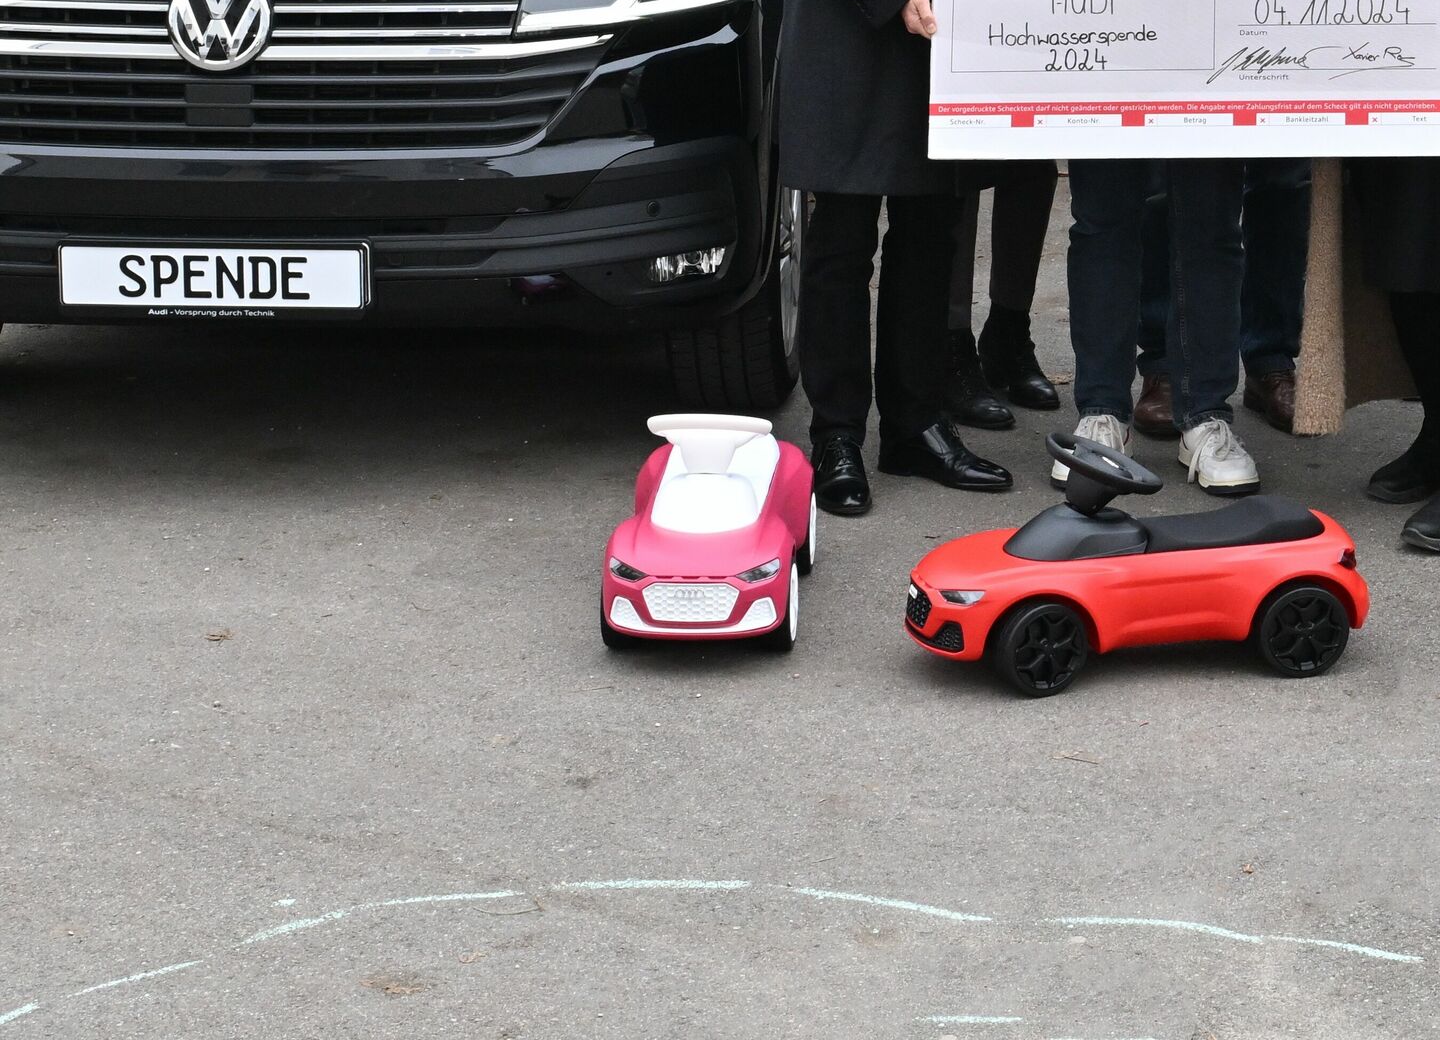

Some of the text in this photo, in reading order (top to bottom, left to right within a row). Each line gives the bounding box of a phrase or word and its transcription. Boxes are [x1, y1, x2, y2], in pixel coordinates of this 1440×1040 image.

[988, 22, 1158, 47] Hochwasserspende
[1045, 48, 1108, 72] 2024
[952, 105, 996, 114] vorgedruckte
[1070, 104, 1101, 112] geändert
[1120, 104, 1156, 112] gestrichen
[1200, 103, 1226, 112] Angabe
[1246, 103, 1292, 111] Zahlungsfrist
[1324, 102, 1348, 110] Scheck
[1349, 102, 1361, 111] gilt
[1363, 102, 1373, 110] als
[1394, 102, 1437, 111] geschrieben.
[118, 254, 310, 300] SPENDE
[174, 309, 217, 317] Vorsprung
[218, 309, 242, 317] durch
[244, 309, 275, 317] Technik
